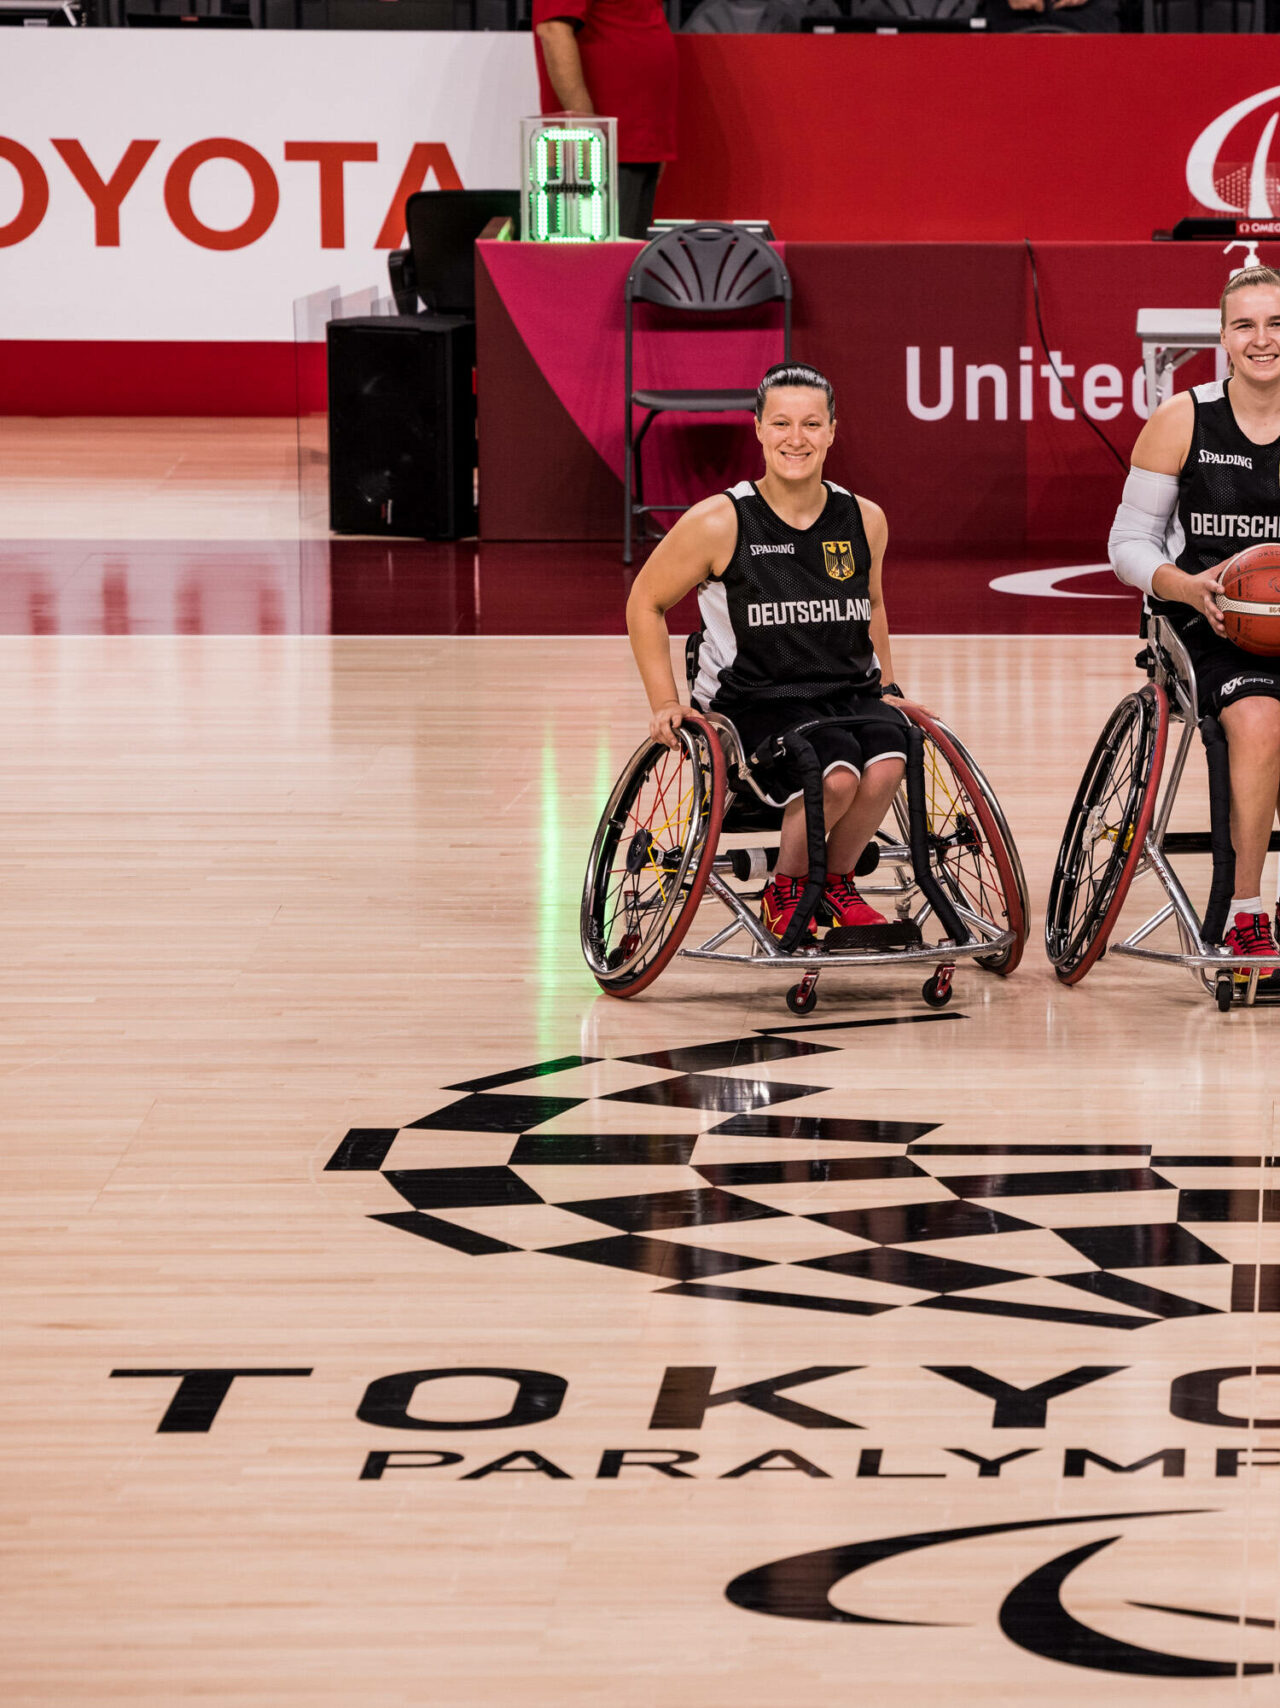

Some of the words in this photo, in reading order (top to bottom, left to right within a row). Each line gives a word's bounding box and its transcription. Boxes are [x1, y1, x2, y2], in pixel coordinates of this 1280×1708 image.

[1198, 449, 1253, 470] SPALDING
[750, 543, 795, 556] SPALDING
[747, 598, 871, 627] DEUTSCHLAND
